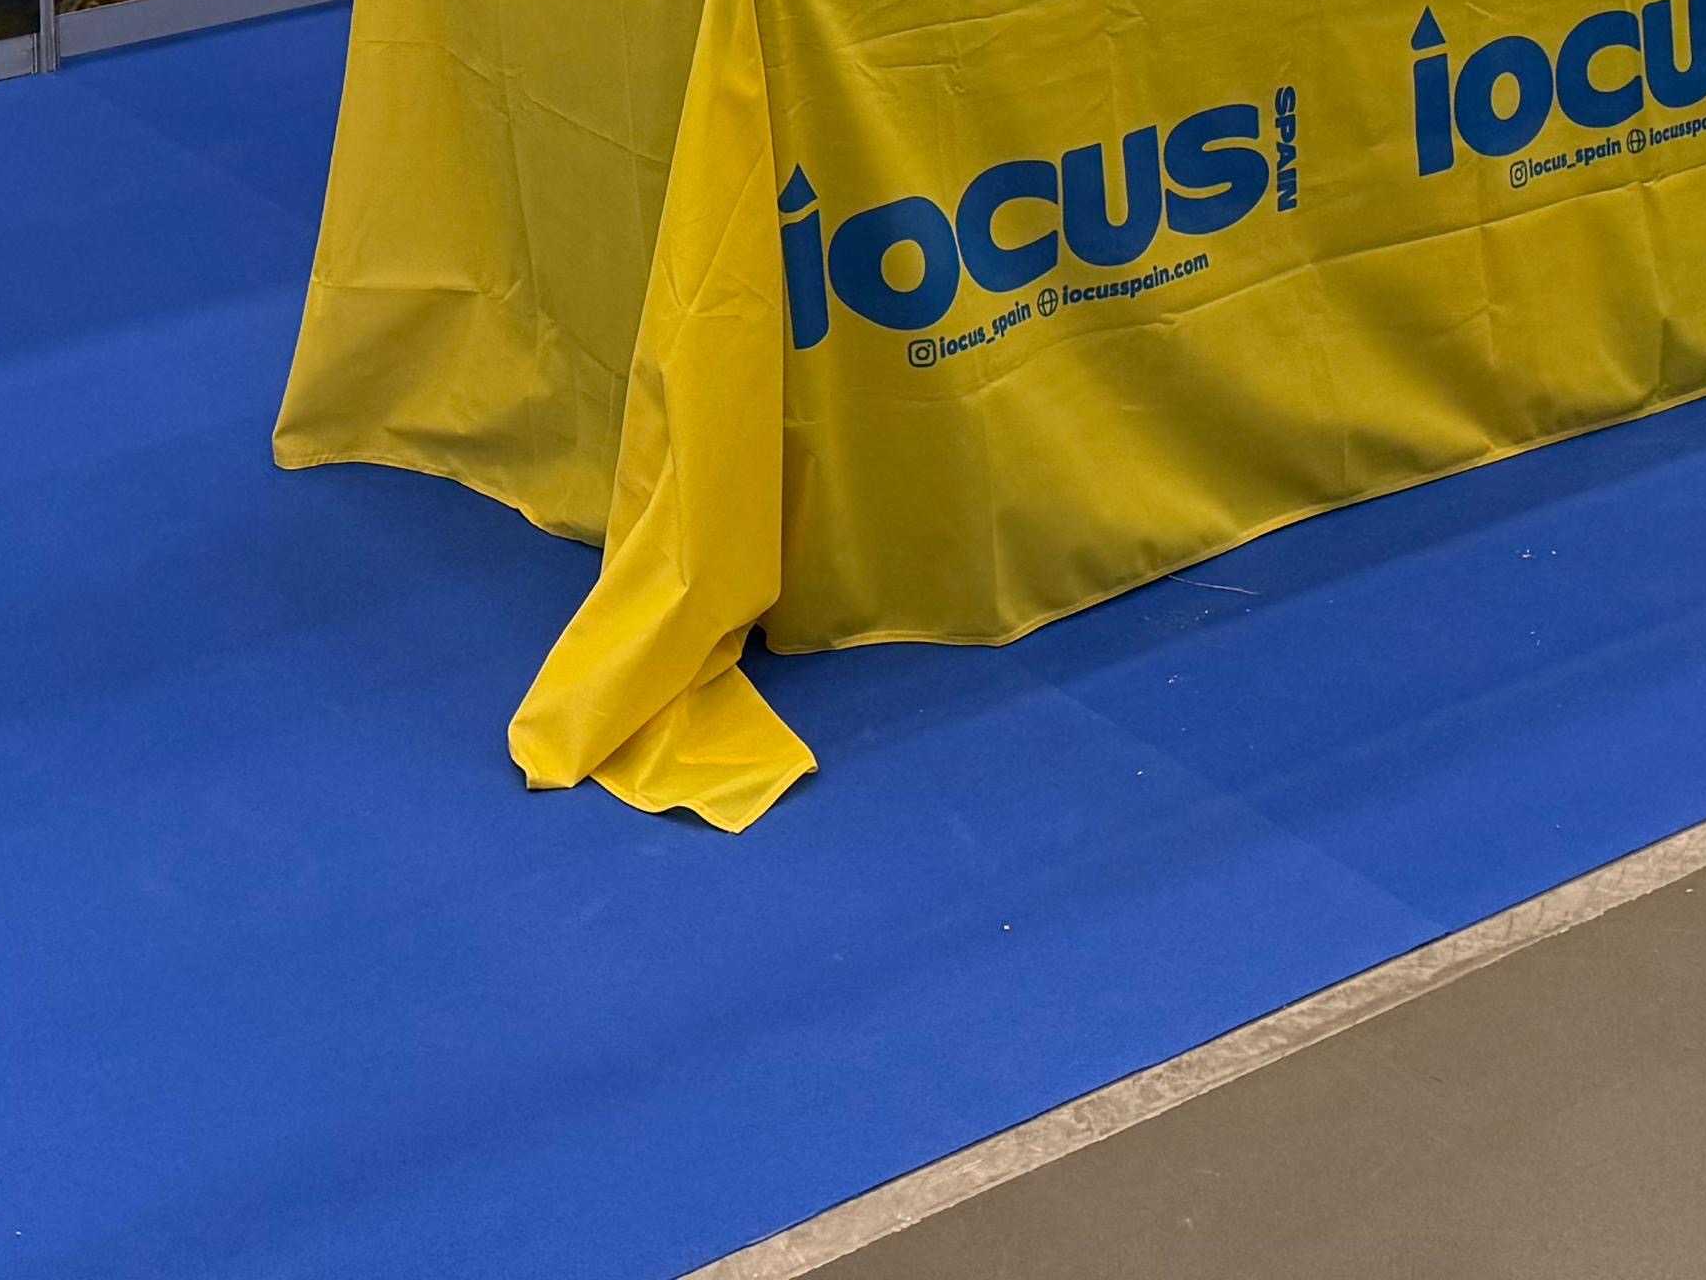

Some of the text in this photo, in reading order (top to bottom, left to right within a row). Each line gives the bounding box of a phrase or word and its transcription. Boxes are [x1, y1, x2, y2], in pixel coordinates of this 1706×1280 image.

[1274, 84, 1298, 213] SPAIN
[1528, 137, 1622, 179] iocus_spain
[938, 251, 1210, 359] iocus_spain iocusspain.com
